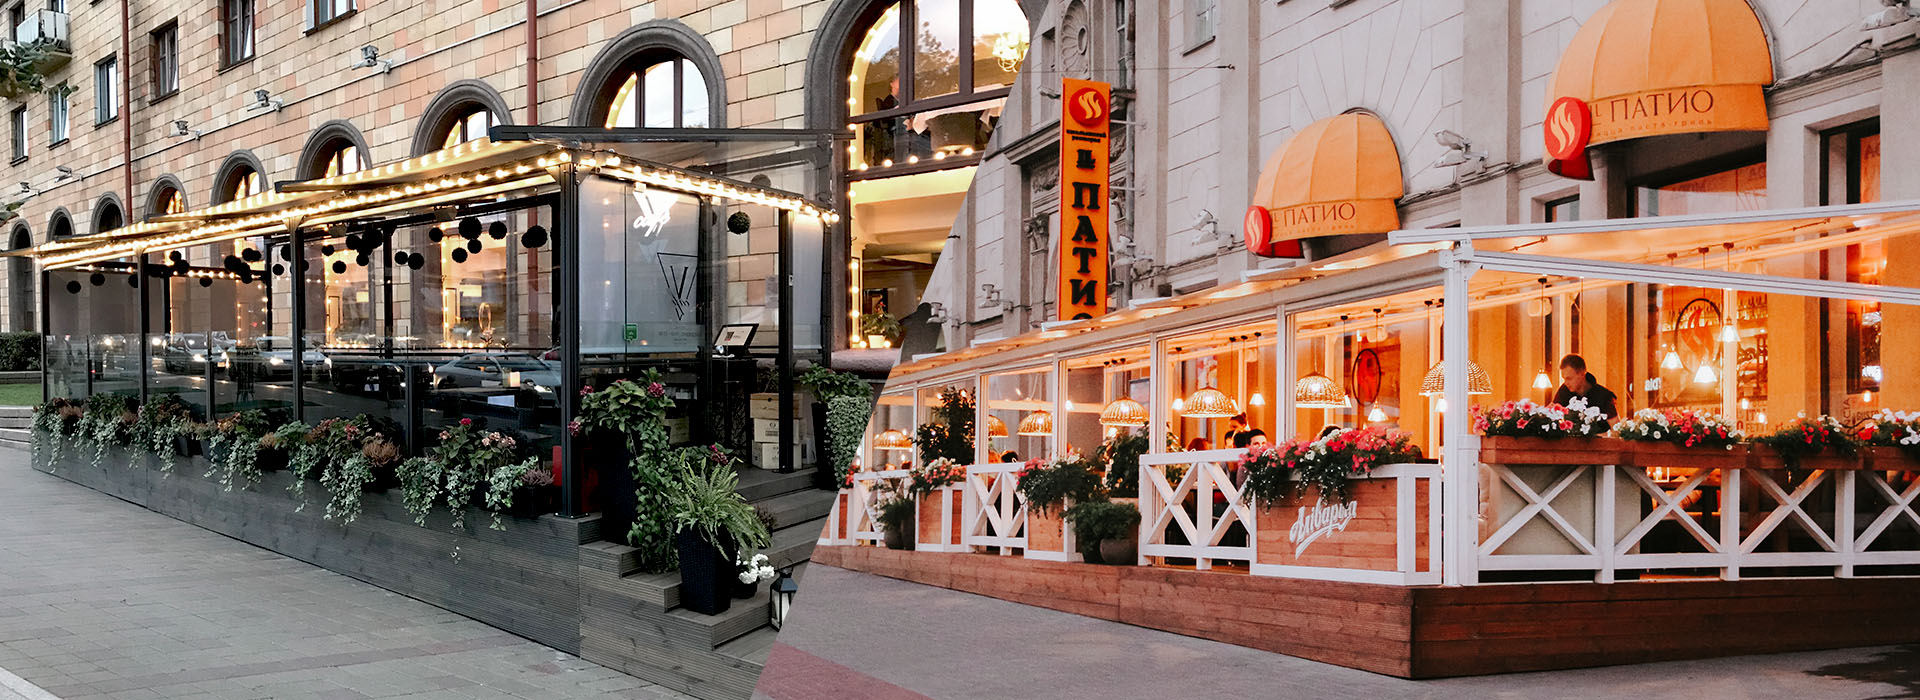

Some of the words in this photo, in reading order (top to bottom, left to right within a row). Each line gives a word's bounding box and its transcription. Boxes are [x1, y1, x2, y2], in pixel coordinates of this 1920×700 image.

[1610, 89, 1714, 123] ПАТИО
[1283, 202, 1356, 228] ПАТИО
[1069, 182, 1100, 319] ПАТИ
